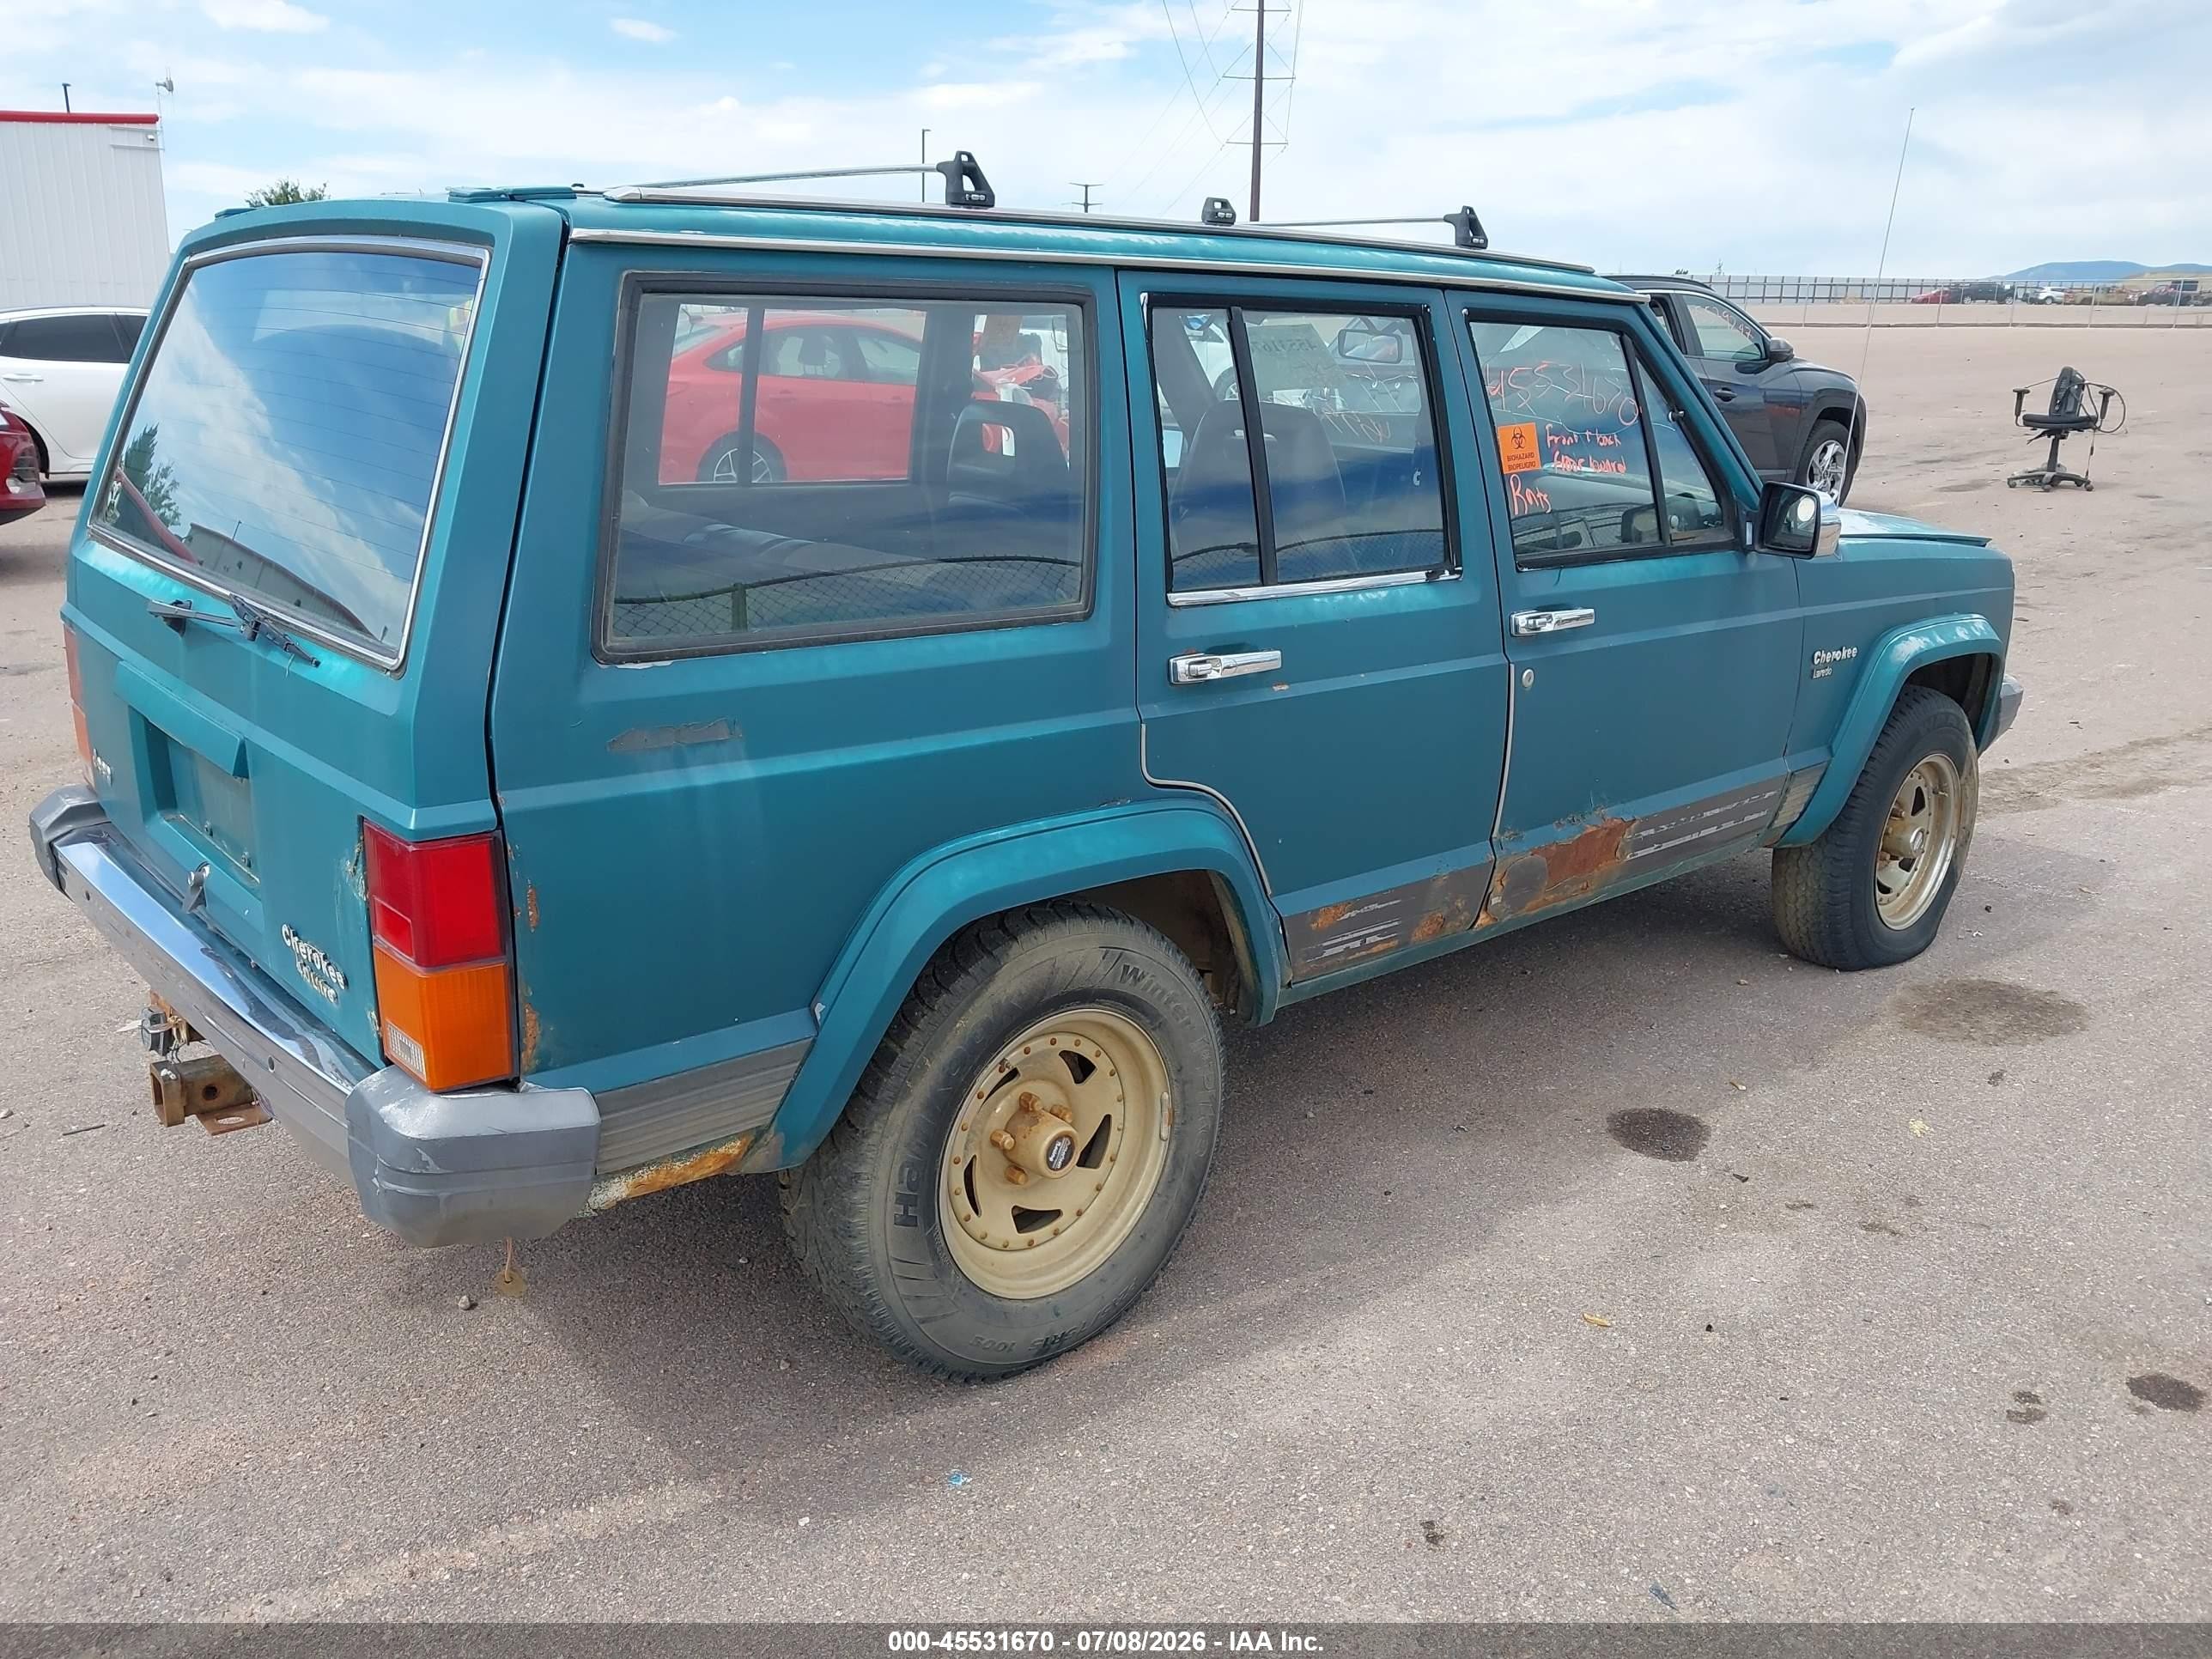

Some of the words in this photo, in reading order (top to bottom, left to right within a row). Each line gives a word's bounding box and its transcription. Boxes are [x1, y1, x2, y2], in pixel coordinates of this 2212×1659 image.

[1485, 360, 1639, 427] 45531670
[1507, 452, 1535, 462] BIOHAZARD
[1508, 460, 1537, 471] BIOPELIGRO
[1509, 473, 1552, 515] Rats
[1814, 647, 1857, 665] Cherokee
[1813, 666, 1832, 678] Laredo
[281, 923, 348, 990] Cherokee
[1119, 962, 1197, 1030] Winter
